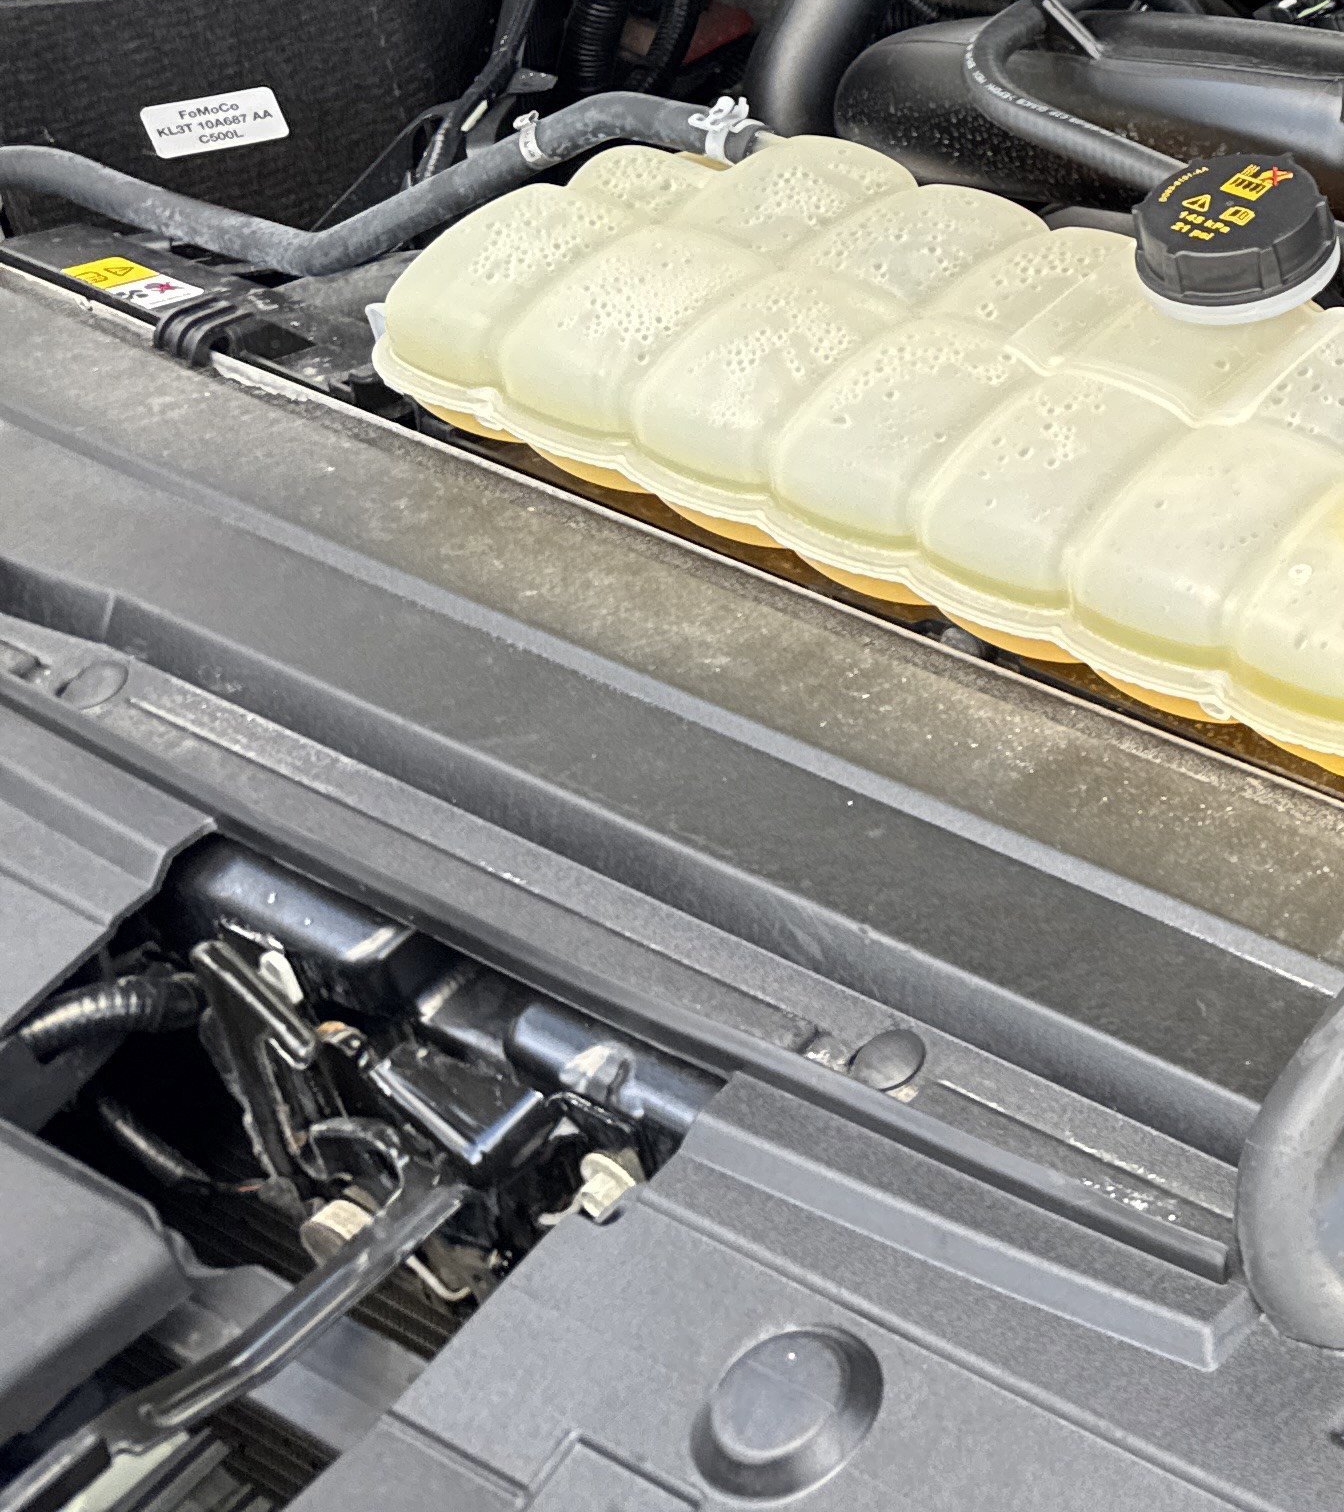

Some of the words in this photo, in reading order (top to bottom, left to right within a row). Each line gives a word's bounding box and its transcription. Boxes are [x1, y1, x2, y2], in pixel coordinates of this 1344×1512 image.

[178, 102, 240, 120] FoMoCo
[157, 123, 193, 138] KL3T
[197, 113, 247, 131] 10A687
[252, 109, 274, 122] AA
[199, 129, 245, 144] C500L
